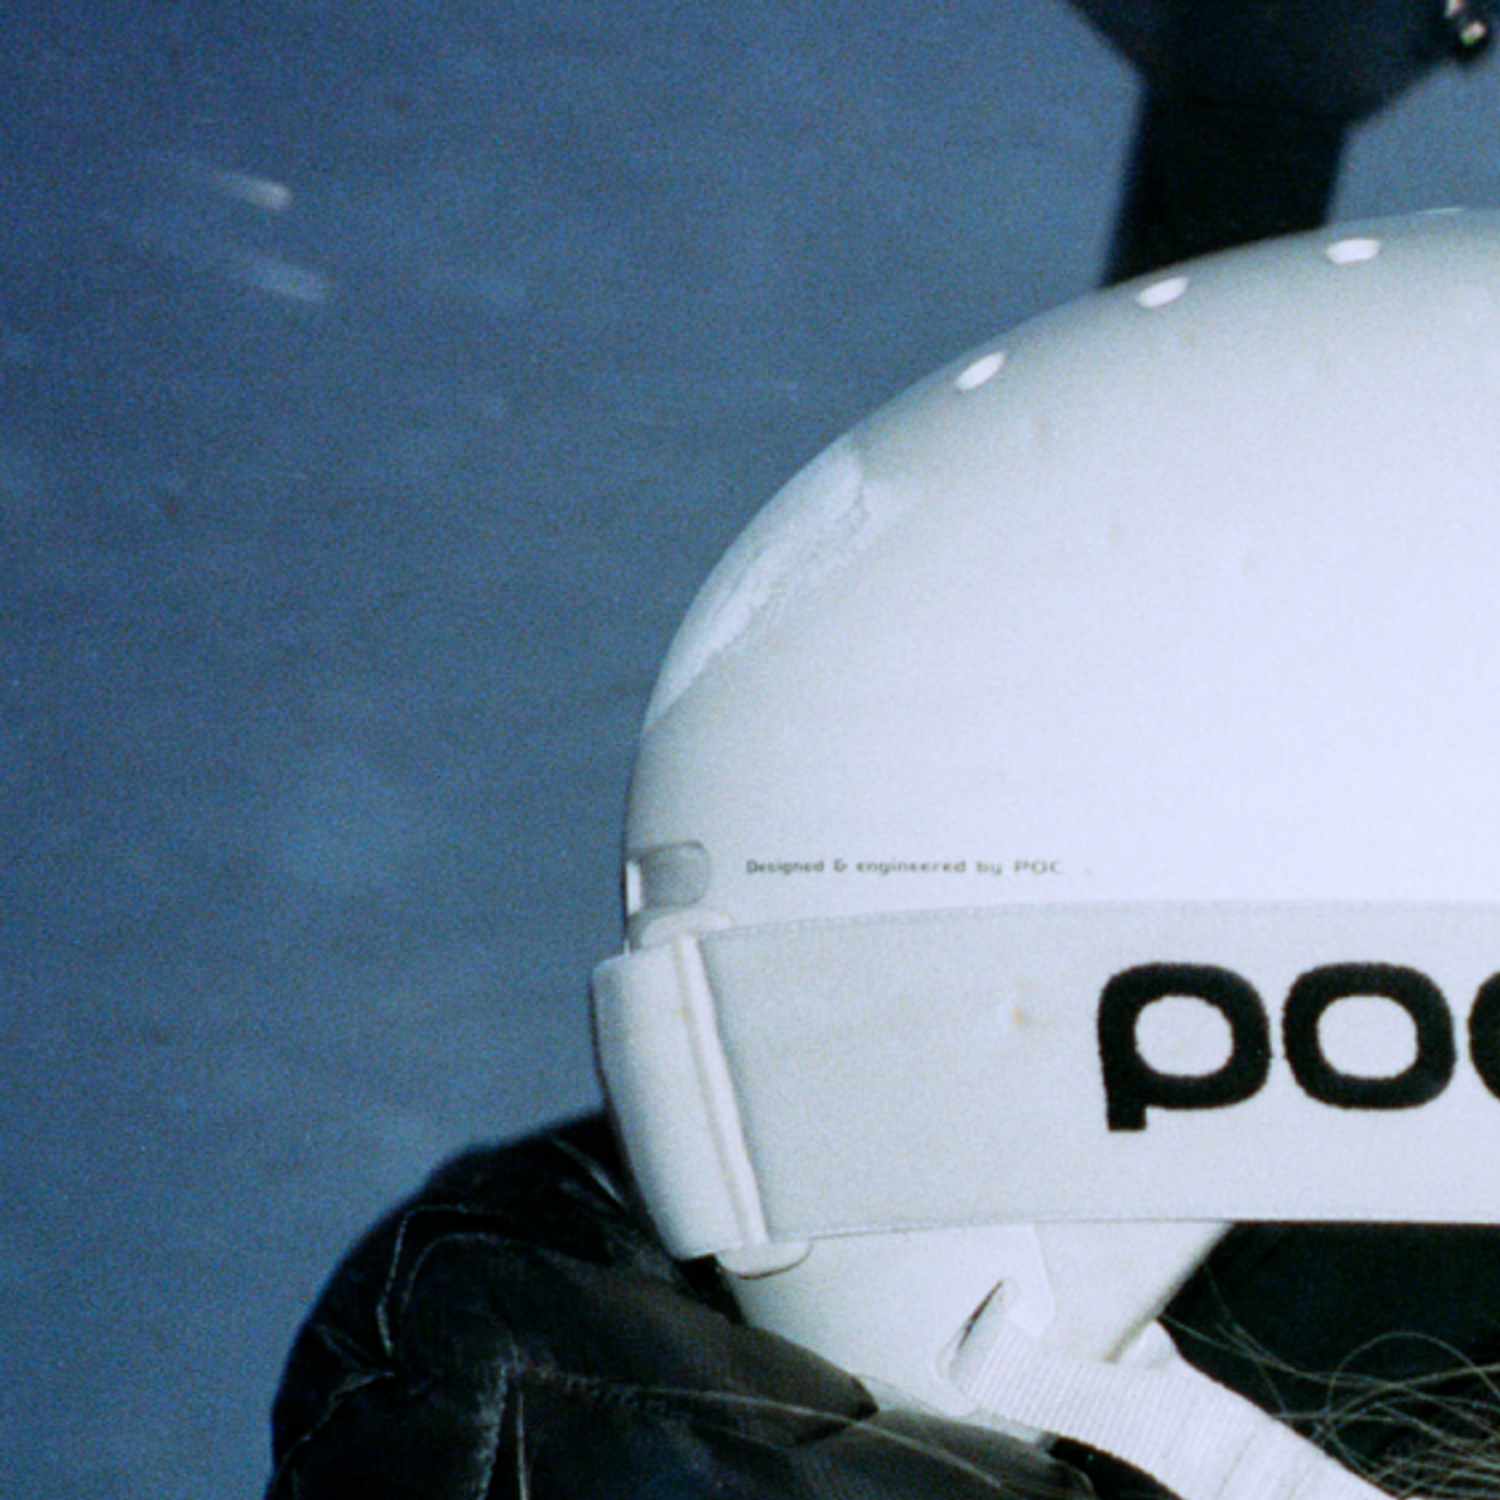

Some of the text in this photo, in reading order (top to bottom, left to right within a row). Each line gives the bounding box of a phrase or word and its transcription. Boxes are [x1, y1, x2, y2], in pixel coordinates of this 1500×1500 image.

[746, 859, 1063, 876] Designed & engineered by POC
